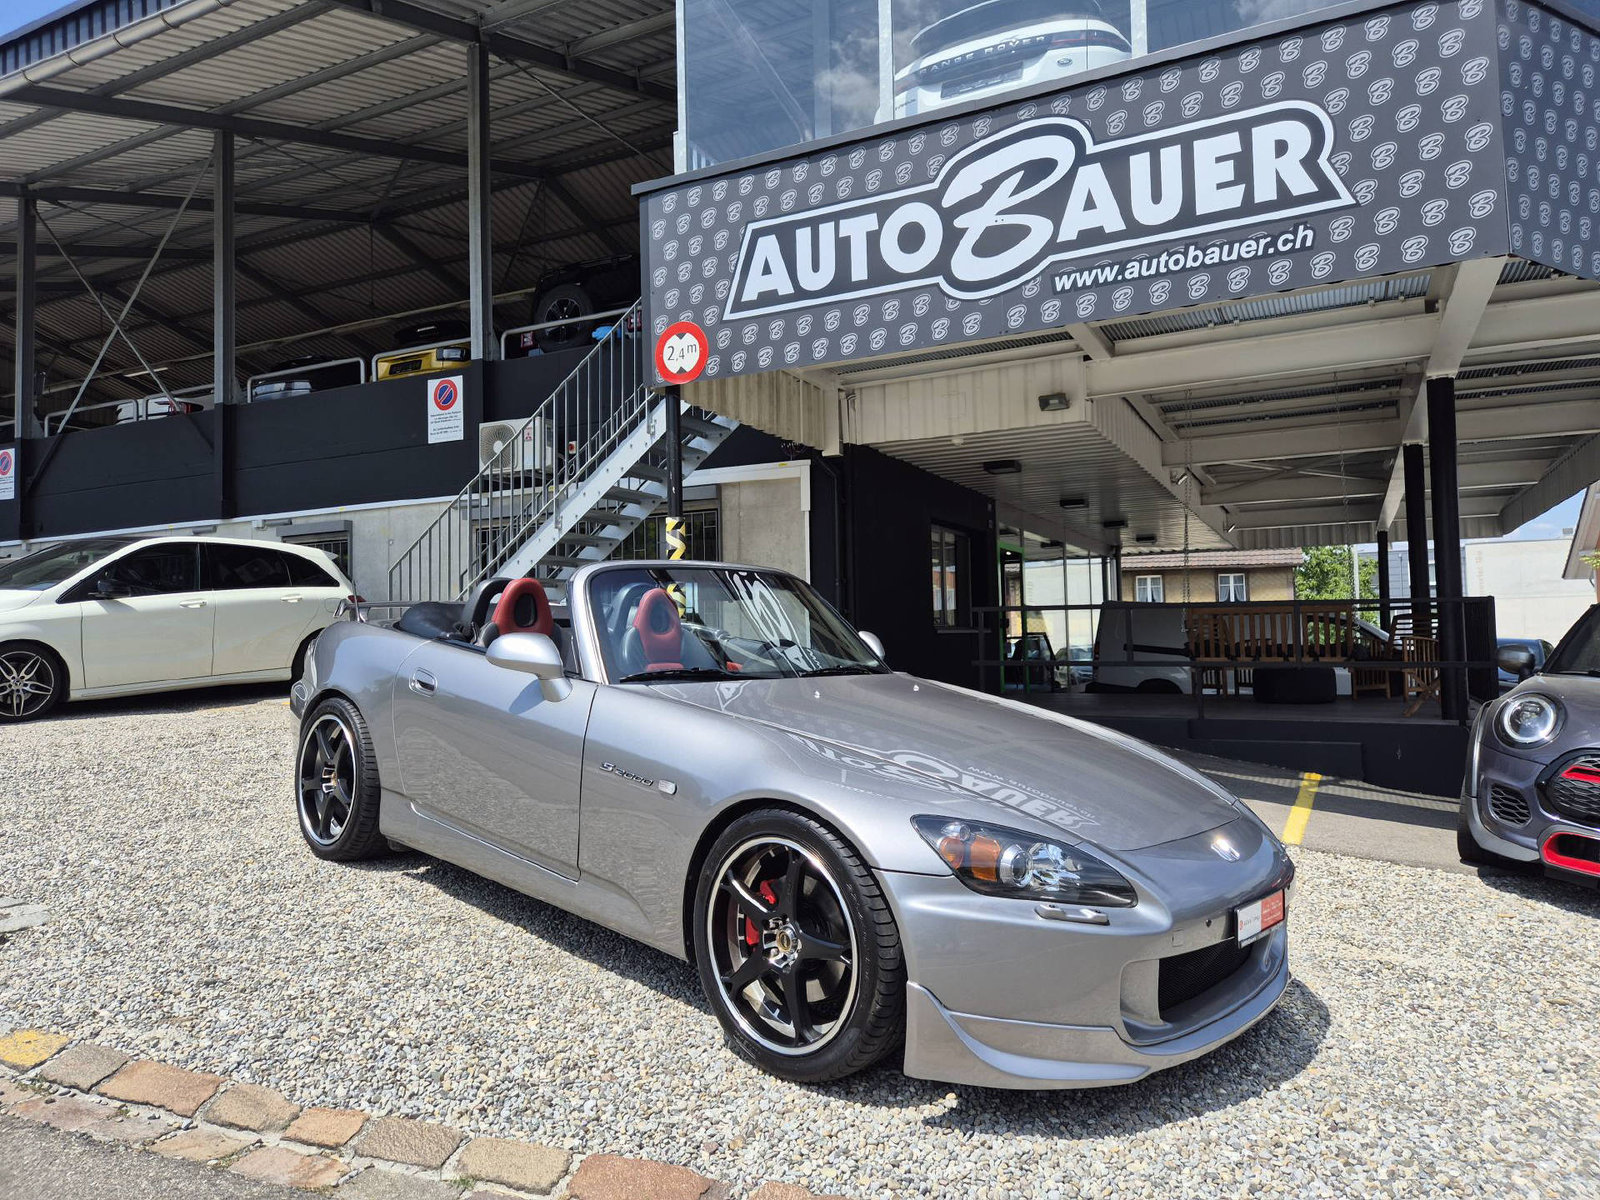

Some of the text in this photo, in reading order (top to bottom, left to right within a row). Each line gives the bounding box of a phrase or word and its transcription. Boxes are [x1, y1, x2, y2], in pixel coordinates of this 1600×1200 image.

[919, 36, 1046, 75] RANGE ROVER
[1054, 225, 1314, 292] www.autobauer.ch
